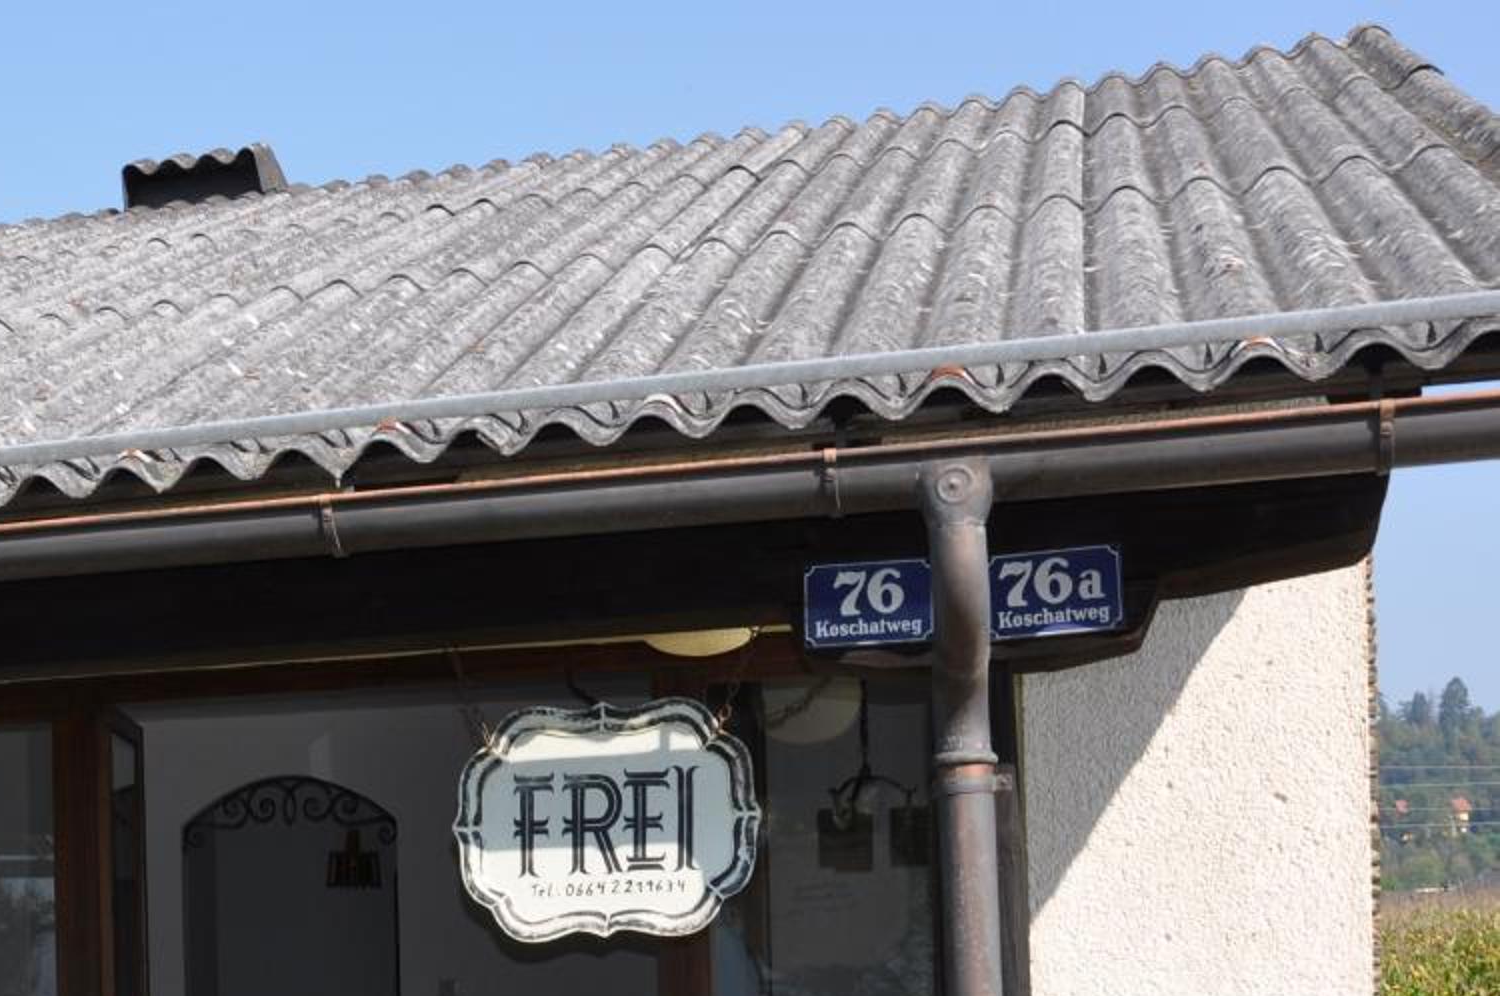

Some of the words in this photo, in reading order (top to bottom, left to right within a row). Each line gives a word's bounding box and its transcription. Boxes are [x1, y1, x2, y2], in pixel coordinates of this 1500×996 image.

[833, 567, 905, 616] 76
[999, 557, 1106, 607] 76a
[815, 618, 923, 639] Koschatweg
[998, 605, 1111, 630] Koschatweg
[513, 765, 700, 878] FREI
